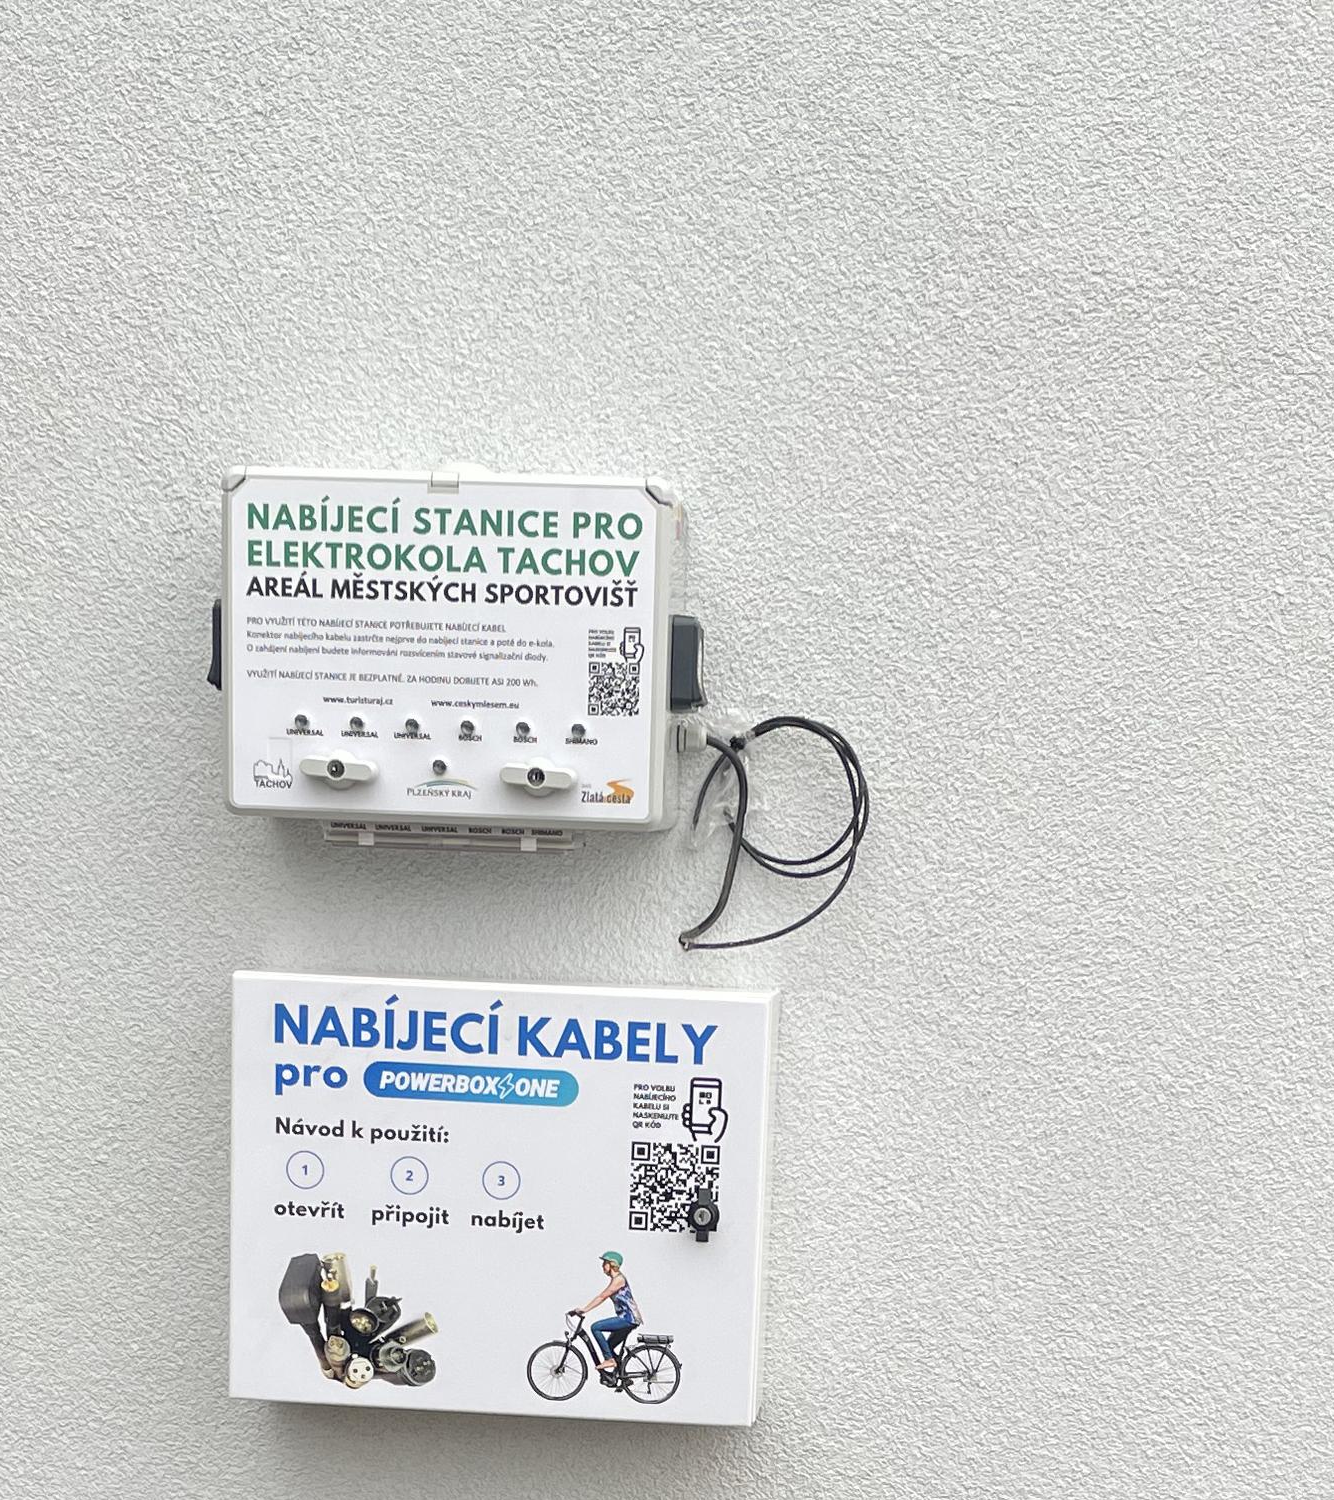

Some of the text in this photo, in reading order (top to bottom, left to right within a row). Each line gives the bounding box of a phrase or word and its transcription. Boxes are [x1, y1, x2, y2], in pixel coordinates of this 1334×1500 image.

[247, 495, 643, 540] NABÍJECÍ STANICE PRO
[247, 539, 640, 577] ELEKTROKOLA TACHOV
[246, 570, 638, 608] AREÁL MĚSTSKÝCH SPORTOVIŠŤ
[246, 617, 263, 625] PRO
[265, 616, 295, 626] VYUŽITÍ
[319, 618, 354, 628] NABÍJECÍ
[355, 620, 387, 629] STANICE
[390, 620, 443, 631] POTŘEBUJETE
[445, 622, 480, 632] NABÍJECÍ
[481, 624, 506, 633] KABEL
[246, 631, 281, 639] Konektor
[325, 632, 351, 641] kabelu
[385, 635, 415, 645] nejprve
[417, 635, 427, 644] do
[460, 638, 488, 646] stanice
[496, 638, 514, 648] poté
[517, 638, 526, 647] do
[246, 643, 254, 652] O
[321, 646, 349, 655] budete
[447, 650, 477, 659] stavové
[246, 668, 277, 679] VYUŽITÍ
[279, 670, 313, 680] NABÍJECÍ
[314, 671, 347, 681] STANICE
[349, 672, 357, 682] JE
[407, 675, 417, 683] ZA
[419, 676, 451, 684] HODINU
[491, 677, 504, 686] ASI
[506, 678, 521, 687] 200
[255, 779, 293, 789] TACHOV
[407, 786, 472, 799] PLZEŇSKÝ KRAJ
[581, 790, 631, 804] Zlatá cesta
[274, 994, 718, 1065] NABÍJECÍ KABELY
[275, 1062, 560, 1099] pro POWERBOX ONE
[633, 1102, 661, 1110] KABELU
[275, 1116, 449, 1144] Návod k použití:
[302, 1165, 308, 1176] 1
[405, 1170, 413, 1181] 2
[497, 1175, 505, 1186] 3
[274, 1201, 345, 1219] otevřít
[371, 1205, 449, 1228] připojit
[471, 1210, 544, 1233] nabíjet
